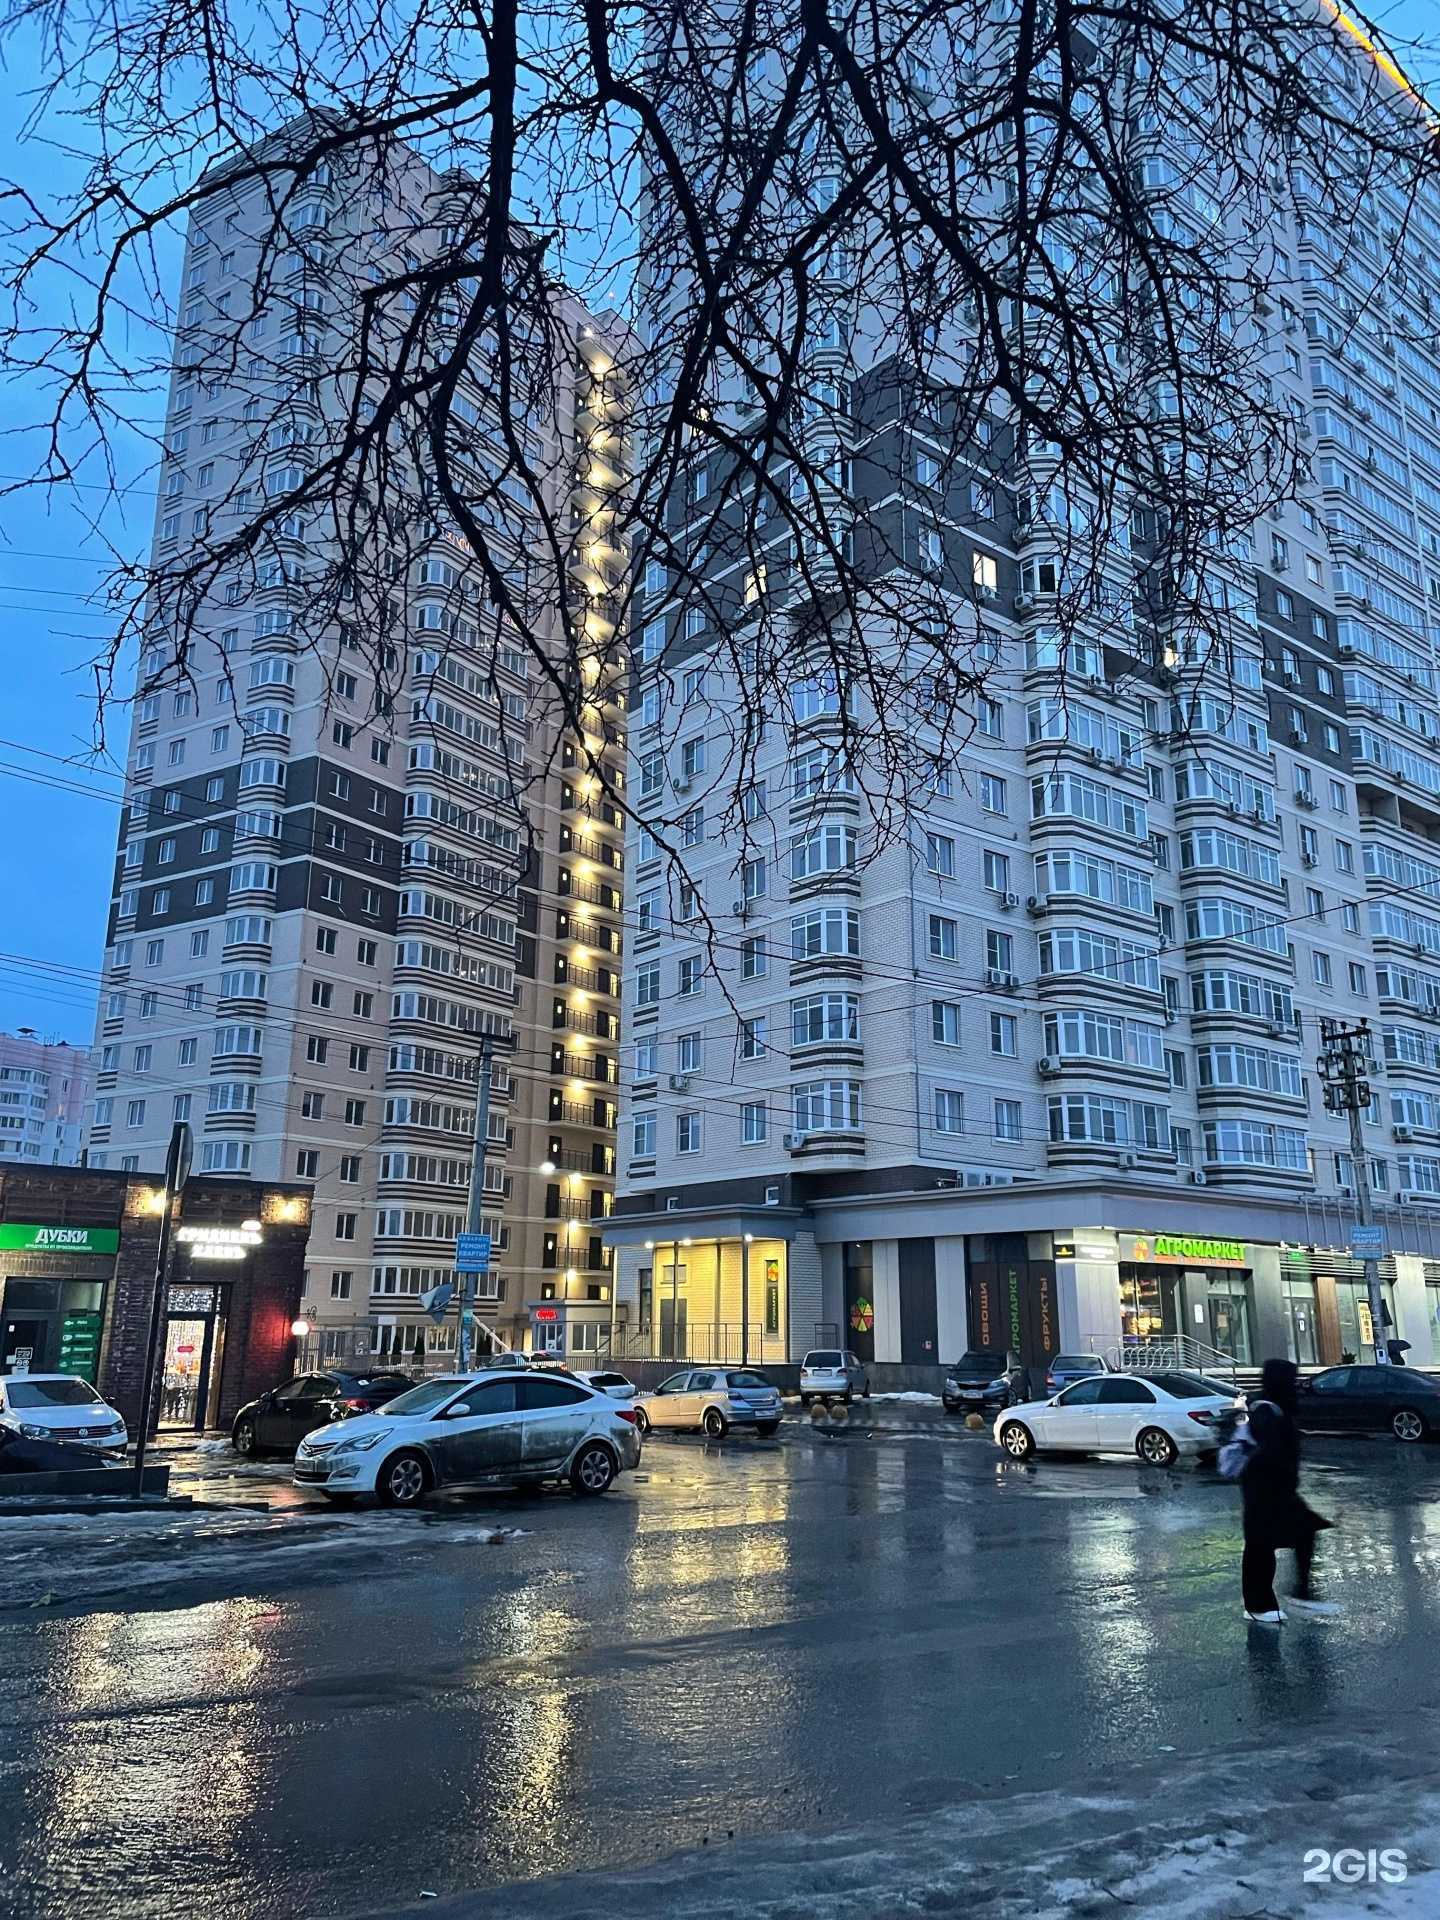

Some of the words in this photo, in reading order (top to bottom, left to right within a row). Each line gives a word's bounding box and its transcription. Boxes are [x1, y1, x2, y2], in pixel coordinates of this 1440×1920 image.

[35, 1228, 88, 1244] ДУБКИ
[1154, 1238, 1245, 1260] АГРОМАРКЕТ
[980, 1282, 989, 1345] ОВОЩИ
[1040, 1278, 1051, 1351] ФРУКТЫ
